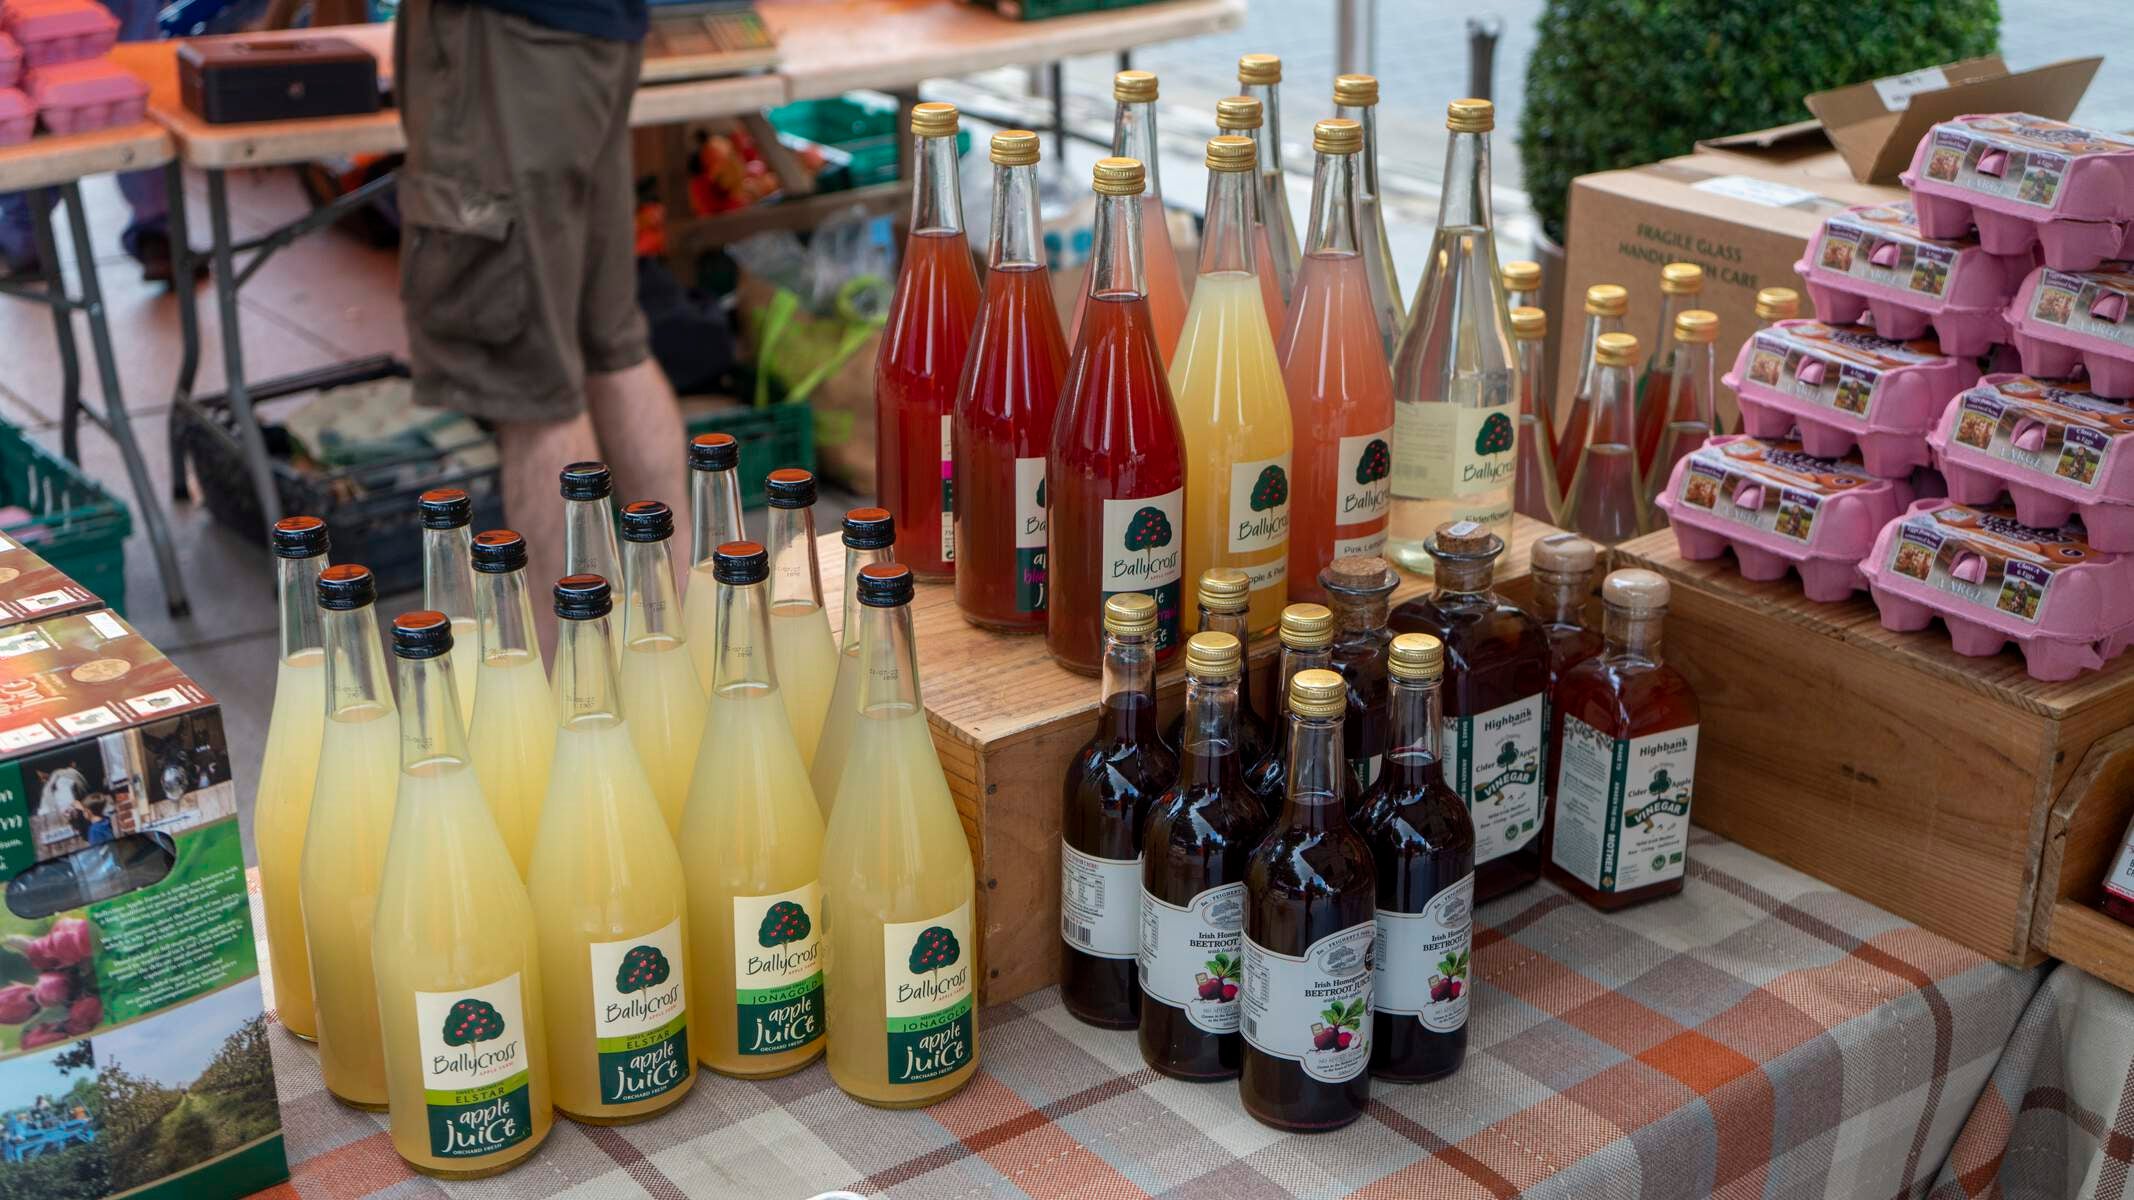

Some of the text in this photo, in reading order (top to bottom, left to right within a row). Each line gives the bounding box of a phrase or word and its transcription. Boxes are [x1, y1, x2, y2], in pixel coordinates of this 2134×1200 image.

[1696, 239, 1742, 262] GLASS
[1249, 574, 1265, 584] pple
[1484, 707, 1532, 731] Highbank
[1640, 737, 1688, 757] Highbank
[1475, 761, 1495, 774] Cider
[1484, 771, 1530, 797] VINEGAR
[1628, 788, 1648, 798] Cider
[1634, 800, 1682, 824] VINEGAR
[1604, 833, 1616, 873] MOTHER
[1190, 938, 1235, 948] BEETROOT
[753, 979, 818, 1005] JONAGOLD
[1305, 984, 1353, 998] BEETROOT
[1314, 980, 1331, 989] Irish
[769, 996, 811, 1023] apple
[903, 1006, 966, 1032] JONAGOLD
[627, 1030, 670, 1050] ELSTAR
[920, 1022, 960, 1053] apple
[630, 1041, 674, 1074] apple
[911, 1070, 937, 1080] ORCHARD
[456, 1087, 505, 1104] ELSTAR
[622, 1090, 651, 1101] ORCHARD
[460, 1098, 510, 1129] apple
